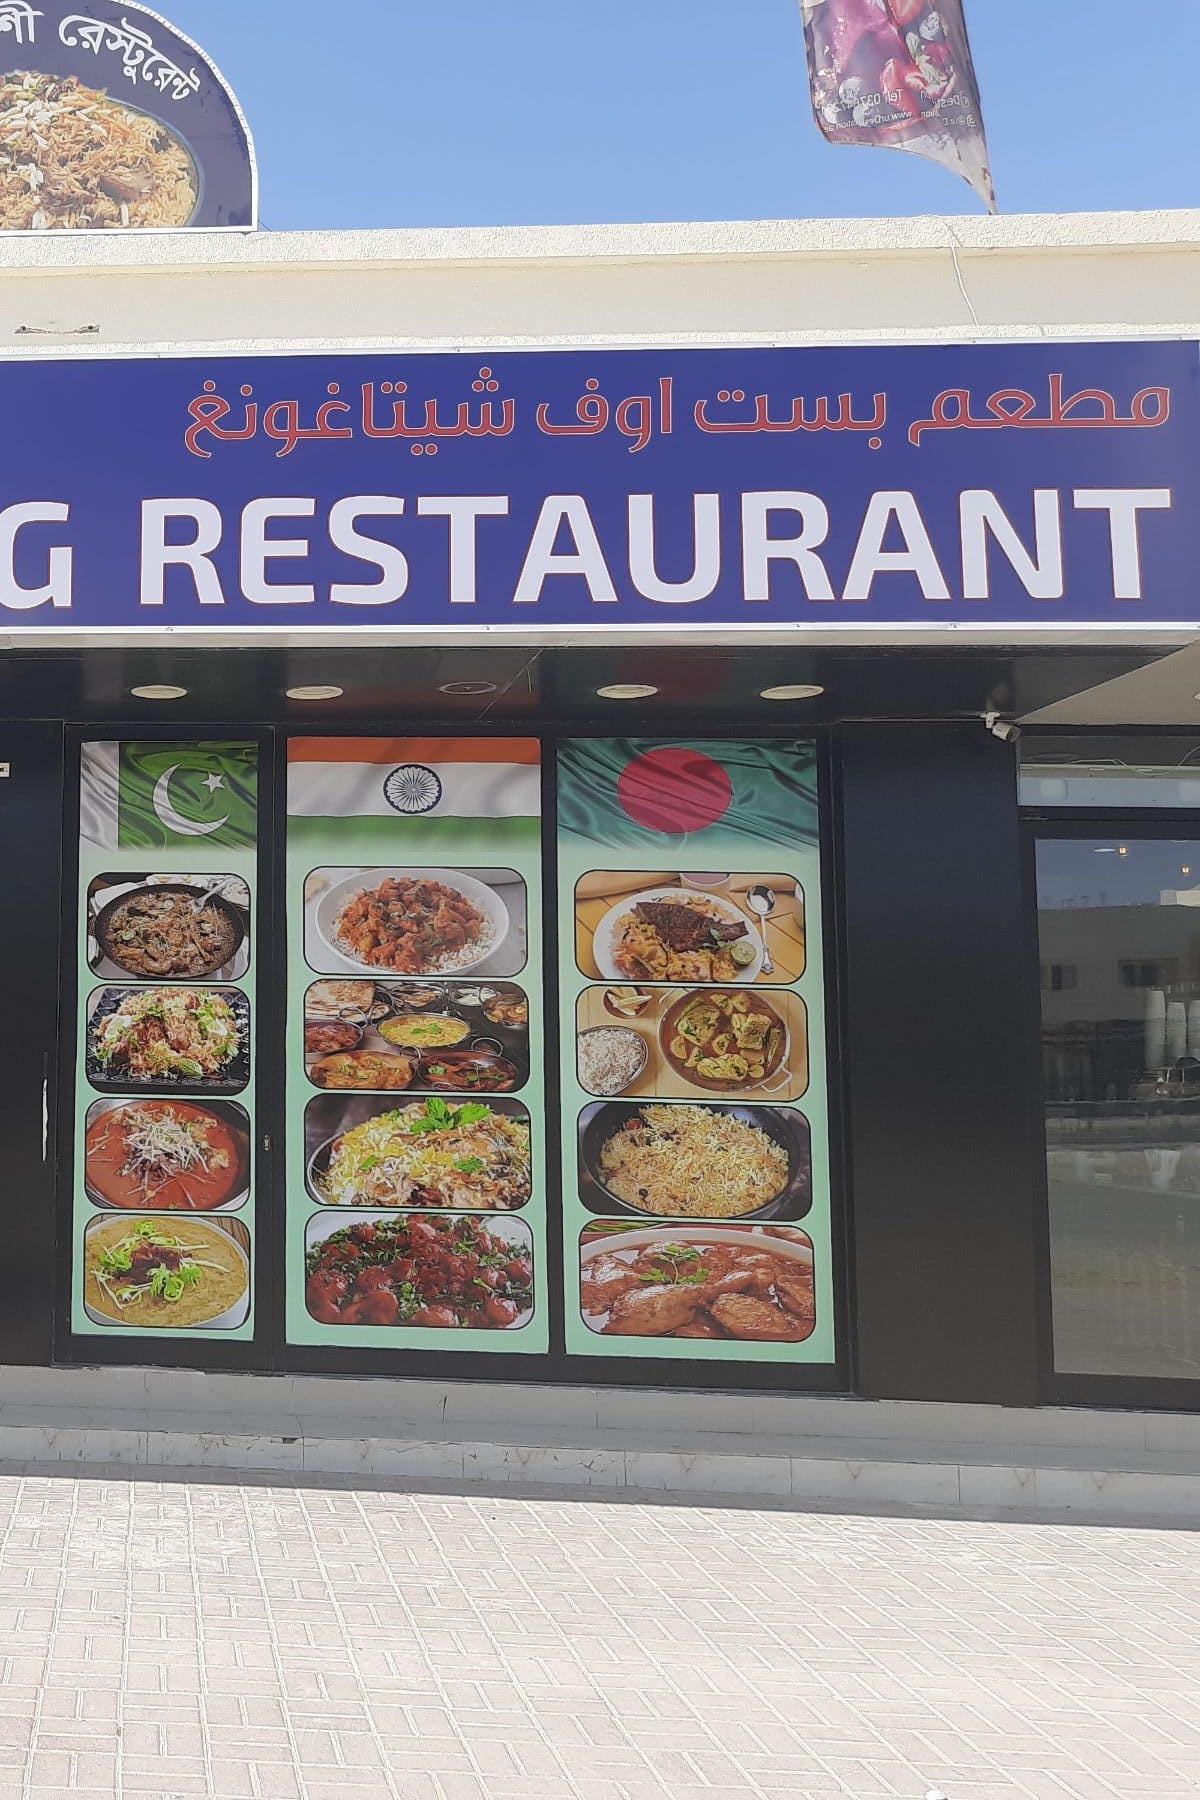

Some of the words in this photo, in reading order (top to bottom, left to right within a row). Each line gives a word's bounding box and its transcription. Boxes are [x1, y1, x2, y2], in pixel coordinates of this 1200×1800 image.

[184, 365, 516, 459] شيتاغونغ
[535, 376, 674, 453] اوف
[693, 388, 887, 452] بست
[907, 372, 1173, 448] مطعم
[138, 487, 1173, 606] RESTAURANT
